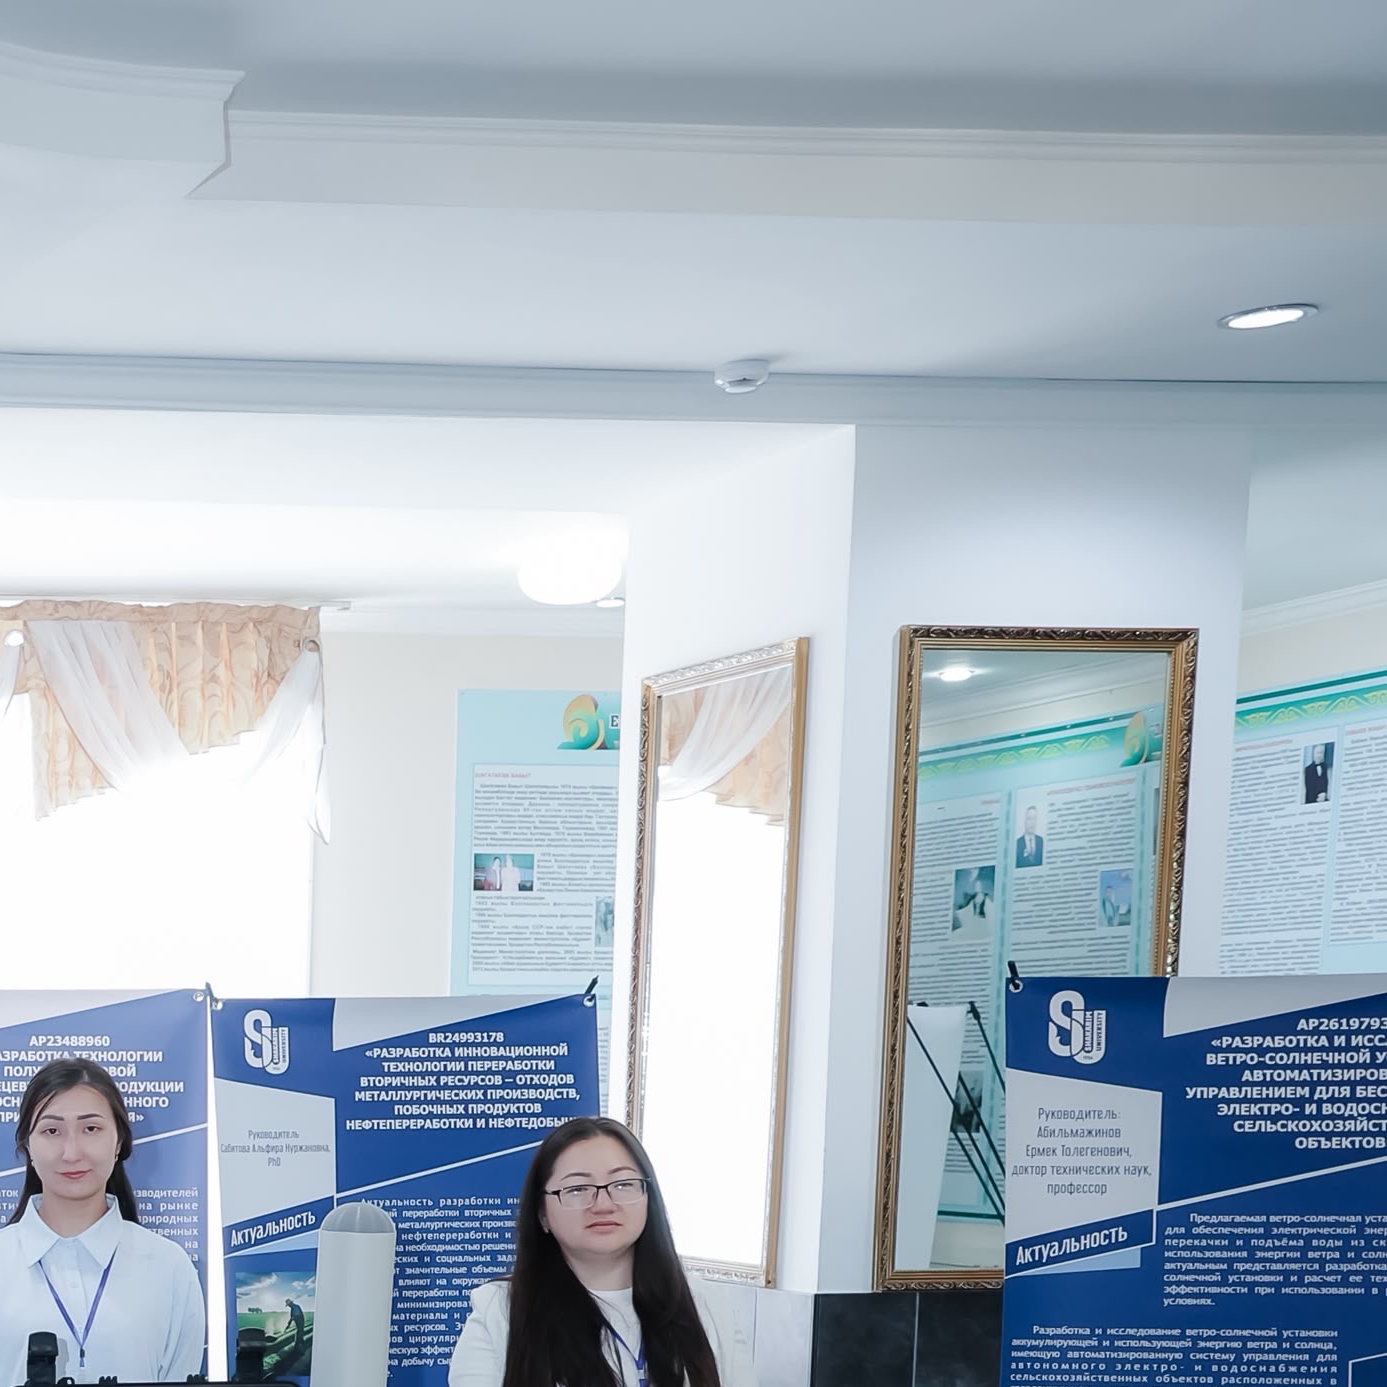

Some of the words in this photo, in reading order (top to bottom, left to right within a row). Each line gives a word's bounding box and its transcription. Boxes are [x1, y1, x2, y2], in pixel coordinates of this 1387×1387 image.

[1296, 1017, 1386, 1030] AP2619793
[29, 1035, 110, 1046] AP23488960
[428, 1031, 504, 1043] BR24993178
[1210, 1035, 1329, 1048] «РАЗРАБОТКА
[1333, 1034, 1346, 1047] И
[364, 1046, 451, 1058] «РАЗРАБОТКА
[454, 1042, 568, 1058] ИННОВАЦИОННОЙ
[1206, 1049, 1370, 1065] ВЕТРО-СОЛНЕЧНОЙ
[381, 1061, 464, 1072] ТЕХНОЛОГИИ
[467, 1059, 555, 1071] ПЕРЕРАБОТКИ
[360, 1075, 437, 1087] ВТОРИЧНЫХ
[440, 1074, 502, 1086] РЕСУРСОВ
[515, 1073, 574, 1086] ОТХОДОВ
[1241, 1068, 1386, 1081] АВТОМАТИЗИРОВ
[119, 1081, 184, 1094] ОДУКЦИИ
[354, 1089, 484, 1101] МЕТАЛЛУРГИЧЕСКИХ
[487, 1088, 580, 1100] ПРОИЗВОДСТВ,
[1185, 1086, 1309, 1098] УПРАВЛЕНИЕМ
[1313, 1086, 1351, 1100] ДЛЯ
[394, 1103, 465, 1115] ПОБОЧНЫХ
[468, 1102, 542, 1115] ПРОДУКТОВ
[1037, 1107, 1120, 1122] Руководитель:
[1216, 1103, 1300, 1115] ЭЛЕКТРО-
[1304, 1102, 1316, 1115] И
[345, 1118, 473, 1130] НЕФТЕПЕРЕРАБОТКИ
[476, 1117, 485, 1128] И
[488, 1117, 572, 1129] НЕФТЕДОБЫ
[1233, 1117, 1386, 1132] СЕЛЬСКОХОЗЯЙСТ
[1036, 1125, 1121, 1138] Абильмажинов
[1025, 1144, 1057, 1159] Ермек
[1060, 1144, 1132, 1158] Толегенович,
[1011, 1164, 1047, 1178] доктор
[1049, 1165, 1120, 1175] технических
[1123, 1165, 1152, 1177] наук,
[1046, 1181, 1107, 1196] профессор
[230, 1210, 315, 1247] Актуальность
[1015, 1226, 1127, 1265] Актуальность
